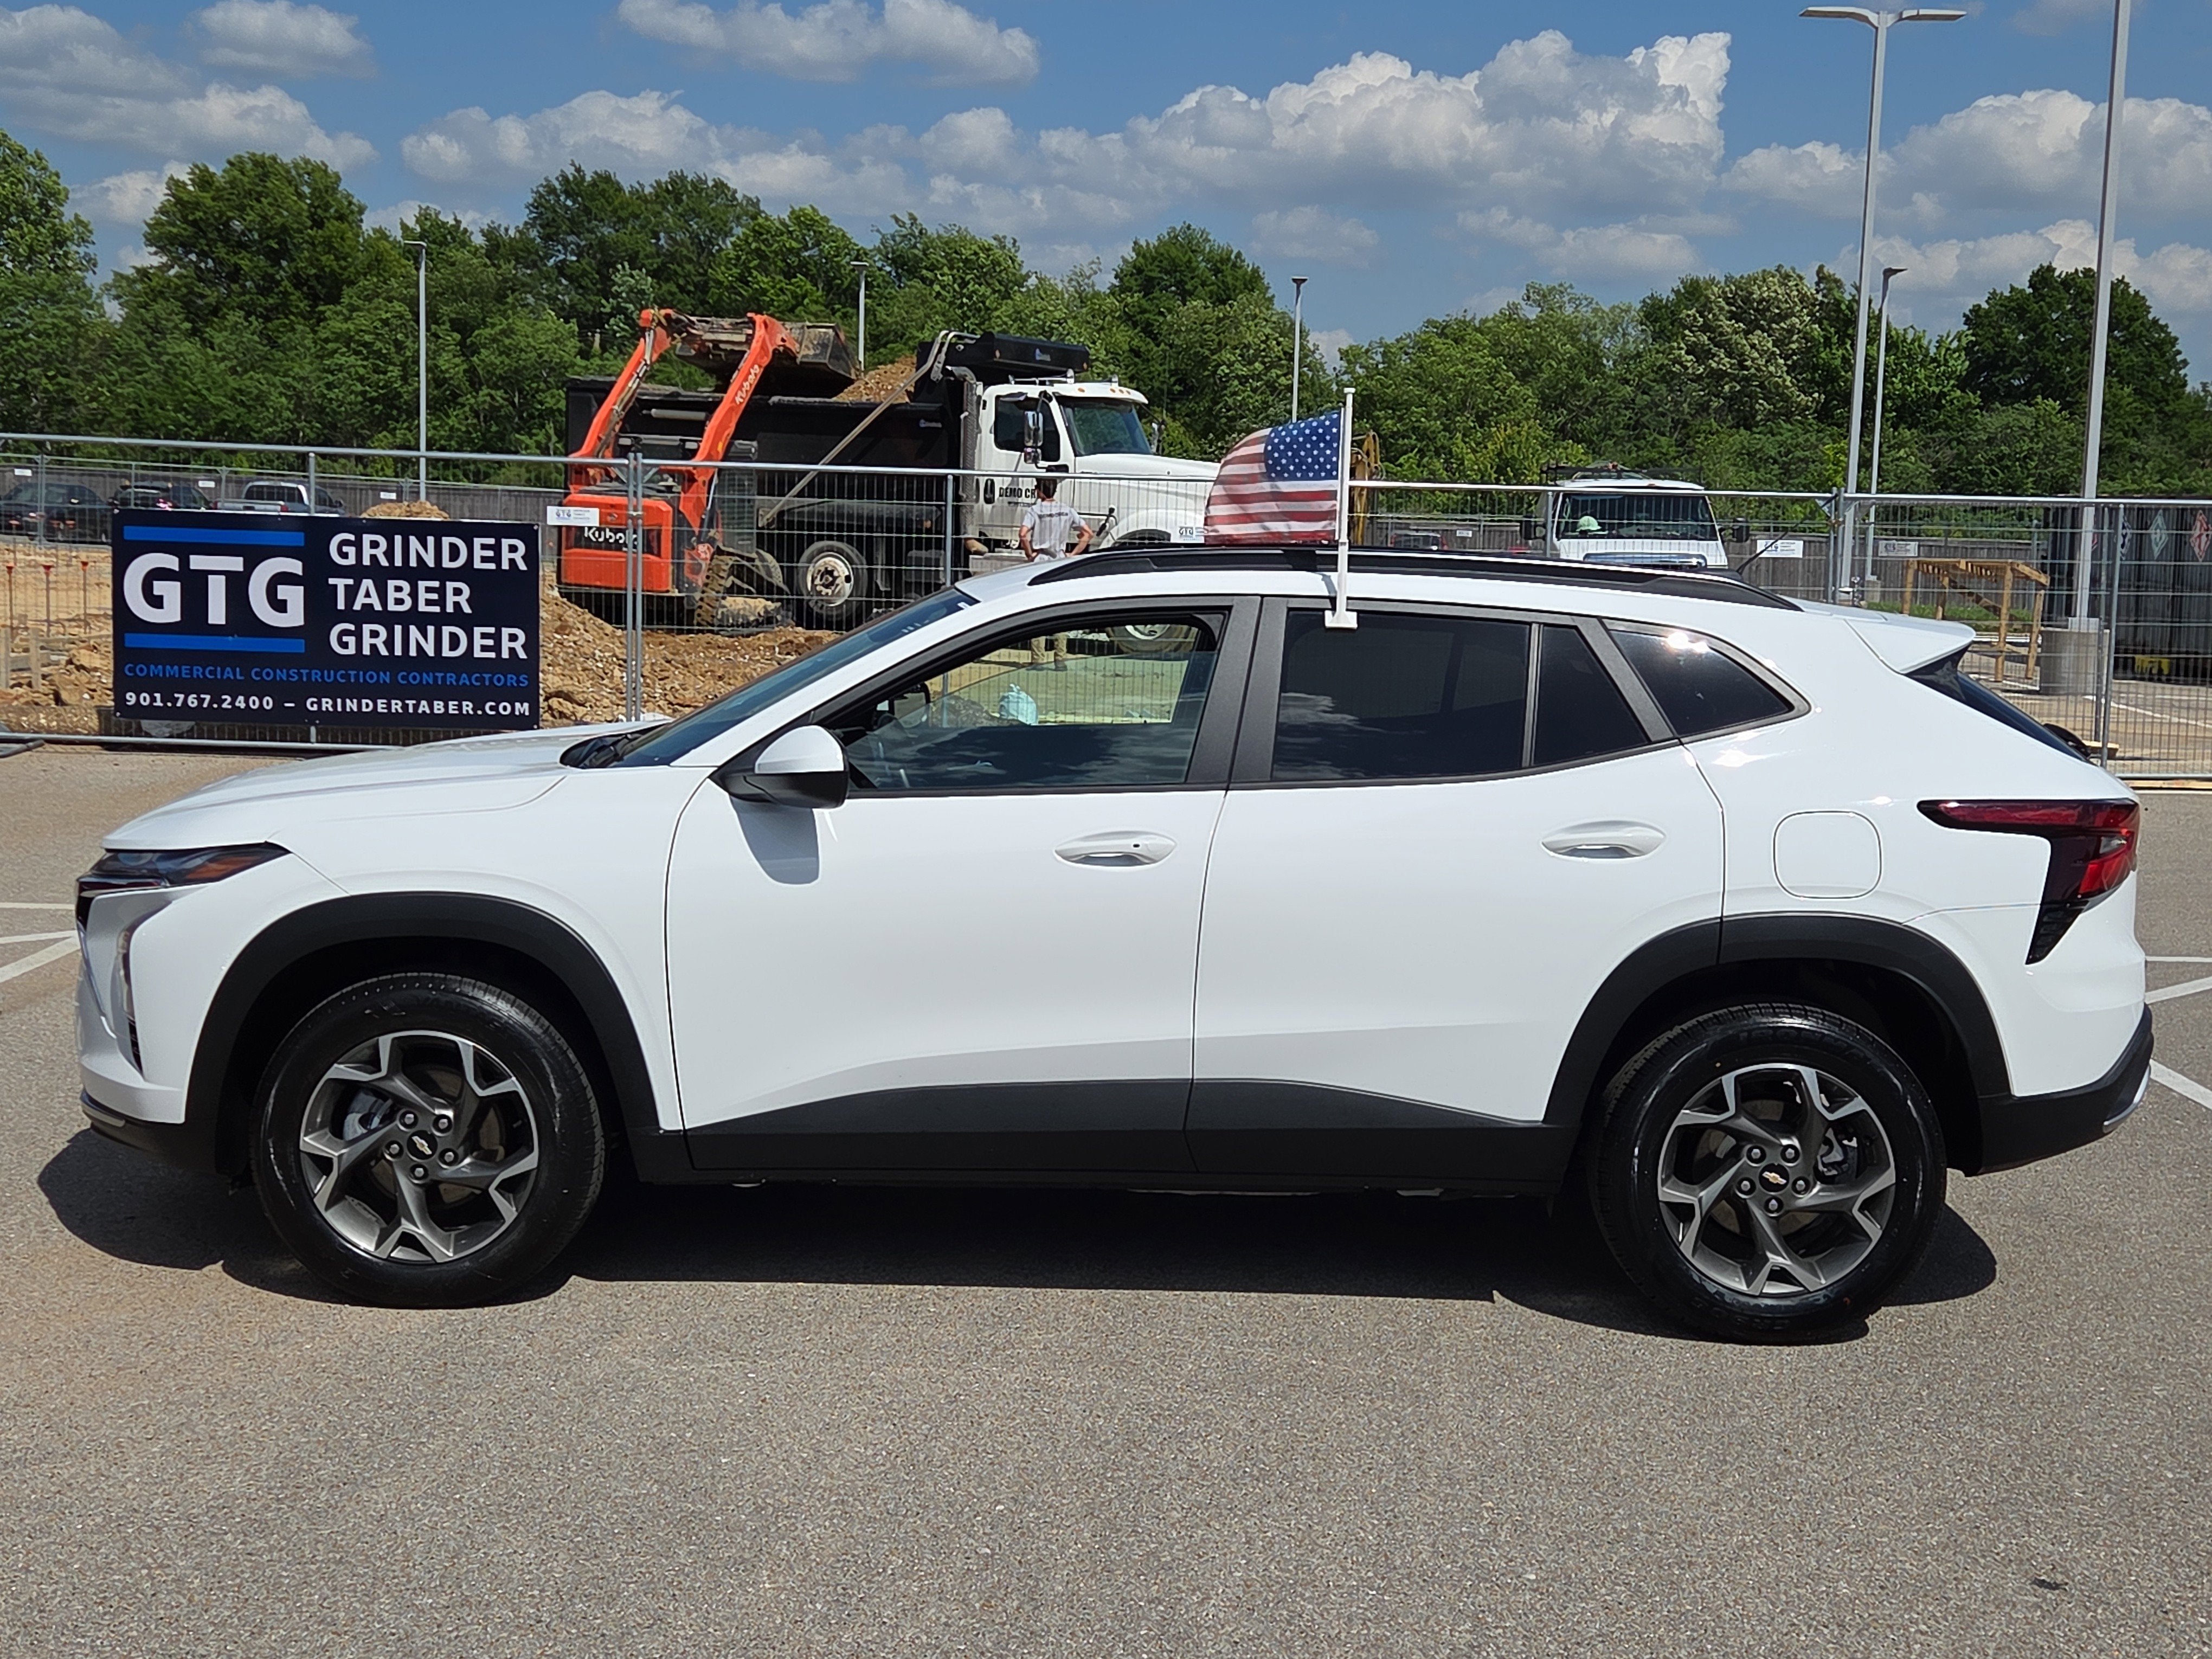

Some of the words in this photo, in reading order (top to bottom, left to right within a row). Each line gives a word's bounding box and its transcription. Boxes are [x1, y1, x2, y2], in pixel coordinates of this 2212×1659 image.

[735, 364, 760, 405] Kubota
[999, 487, 1023, 498] DEMO
[1025, 488, 1037, 498] CR
[329, 533, 528, 570] GRINDER
[124, 552, 305, 627] GTG
[328, 578, 472, 614] TABER
[329, 623, 528, 659] GRINDER
[124, 664, 244, 680] COMMERCIAL
[251, 668, 390, 684] CONSTRUCTION
[397, 672, 529, 687] CONTRACTORS
[126, 692, 273, 710] 901.767.2400
[306, 697, 530, 716] GRINDERTABER.COM
